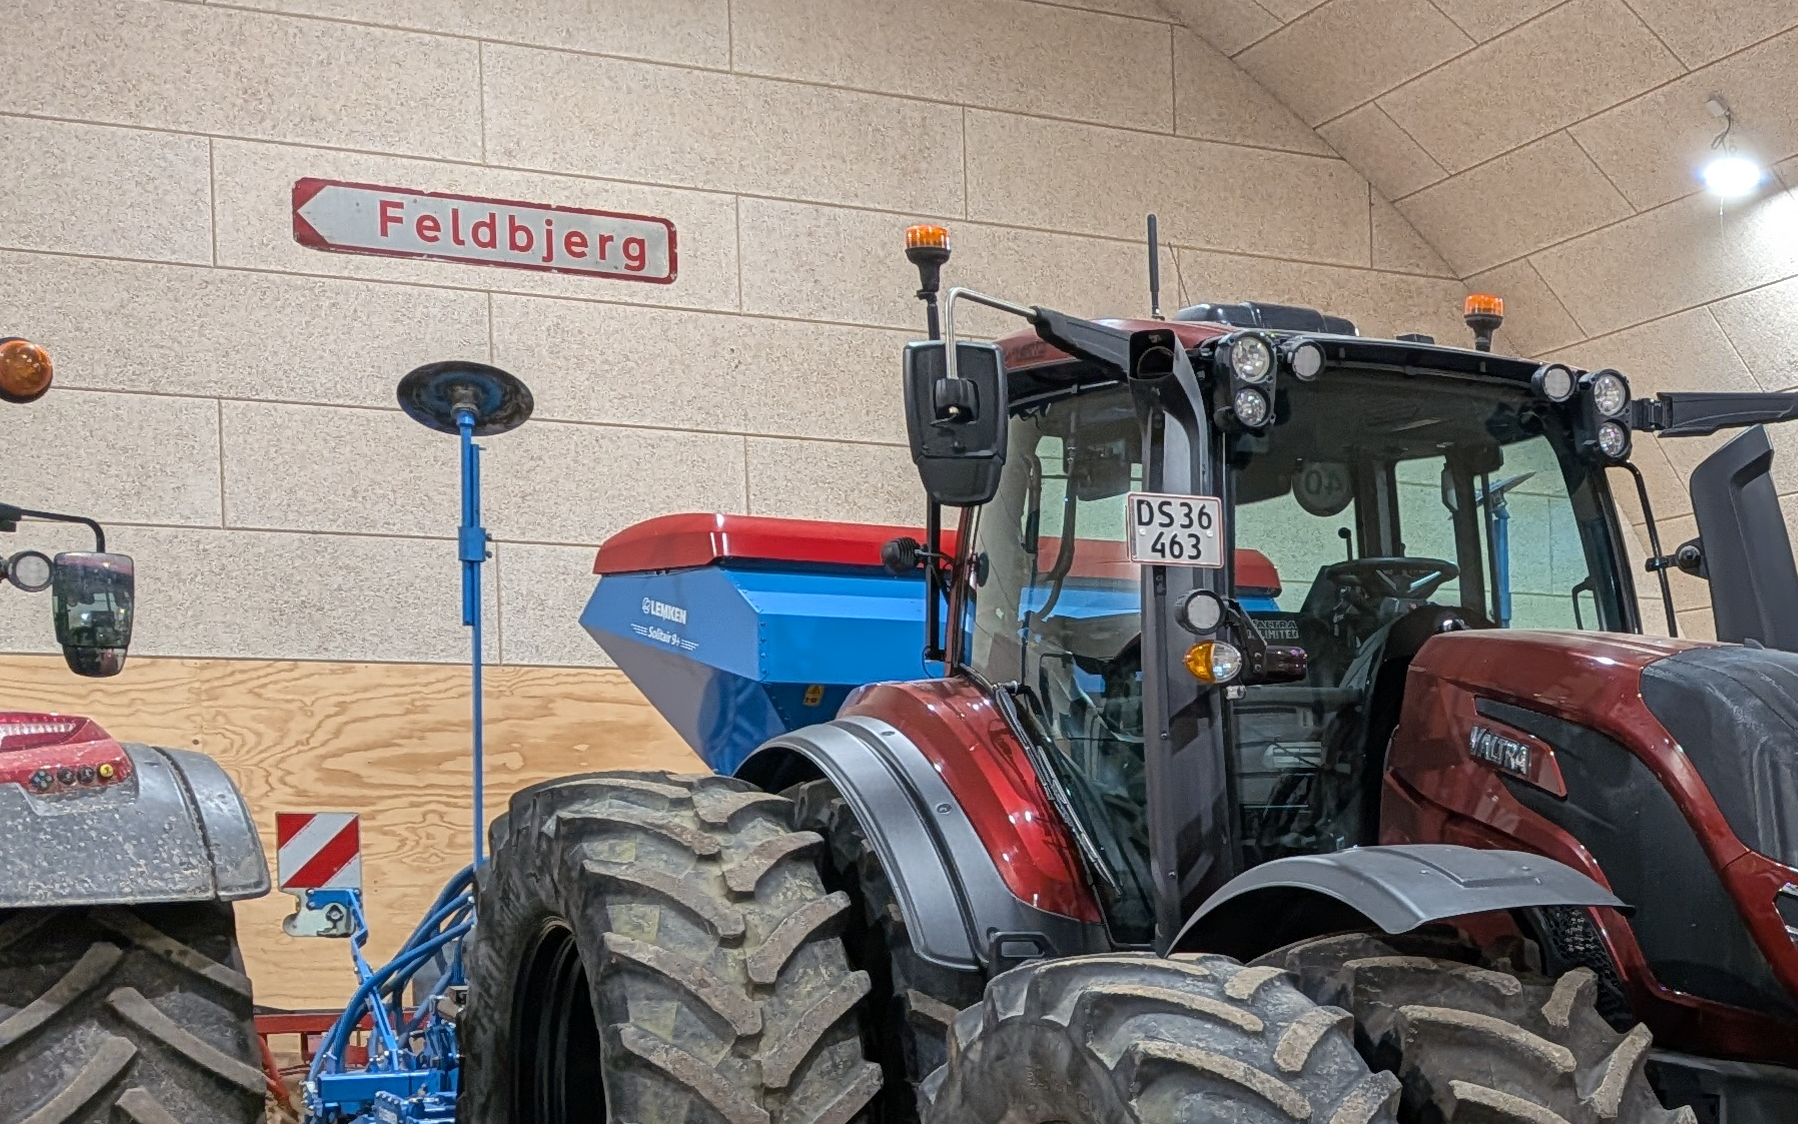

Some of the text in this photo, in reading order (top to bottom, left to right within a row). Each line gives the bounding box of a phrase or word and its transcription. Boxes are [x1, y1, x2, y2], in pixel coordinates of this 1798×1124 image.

[377, 199, 646, 272] Feldbjerg
[1136, 498, 1213, 530] DS36
[1151, 531, 1202, 560] 463
[651, 601, 687, 624] LEMKEN
[648, 626, 671, 643] Solitair
[1469, 727, 1529, 775] VALTRA
